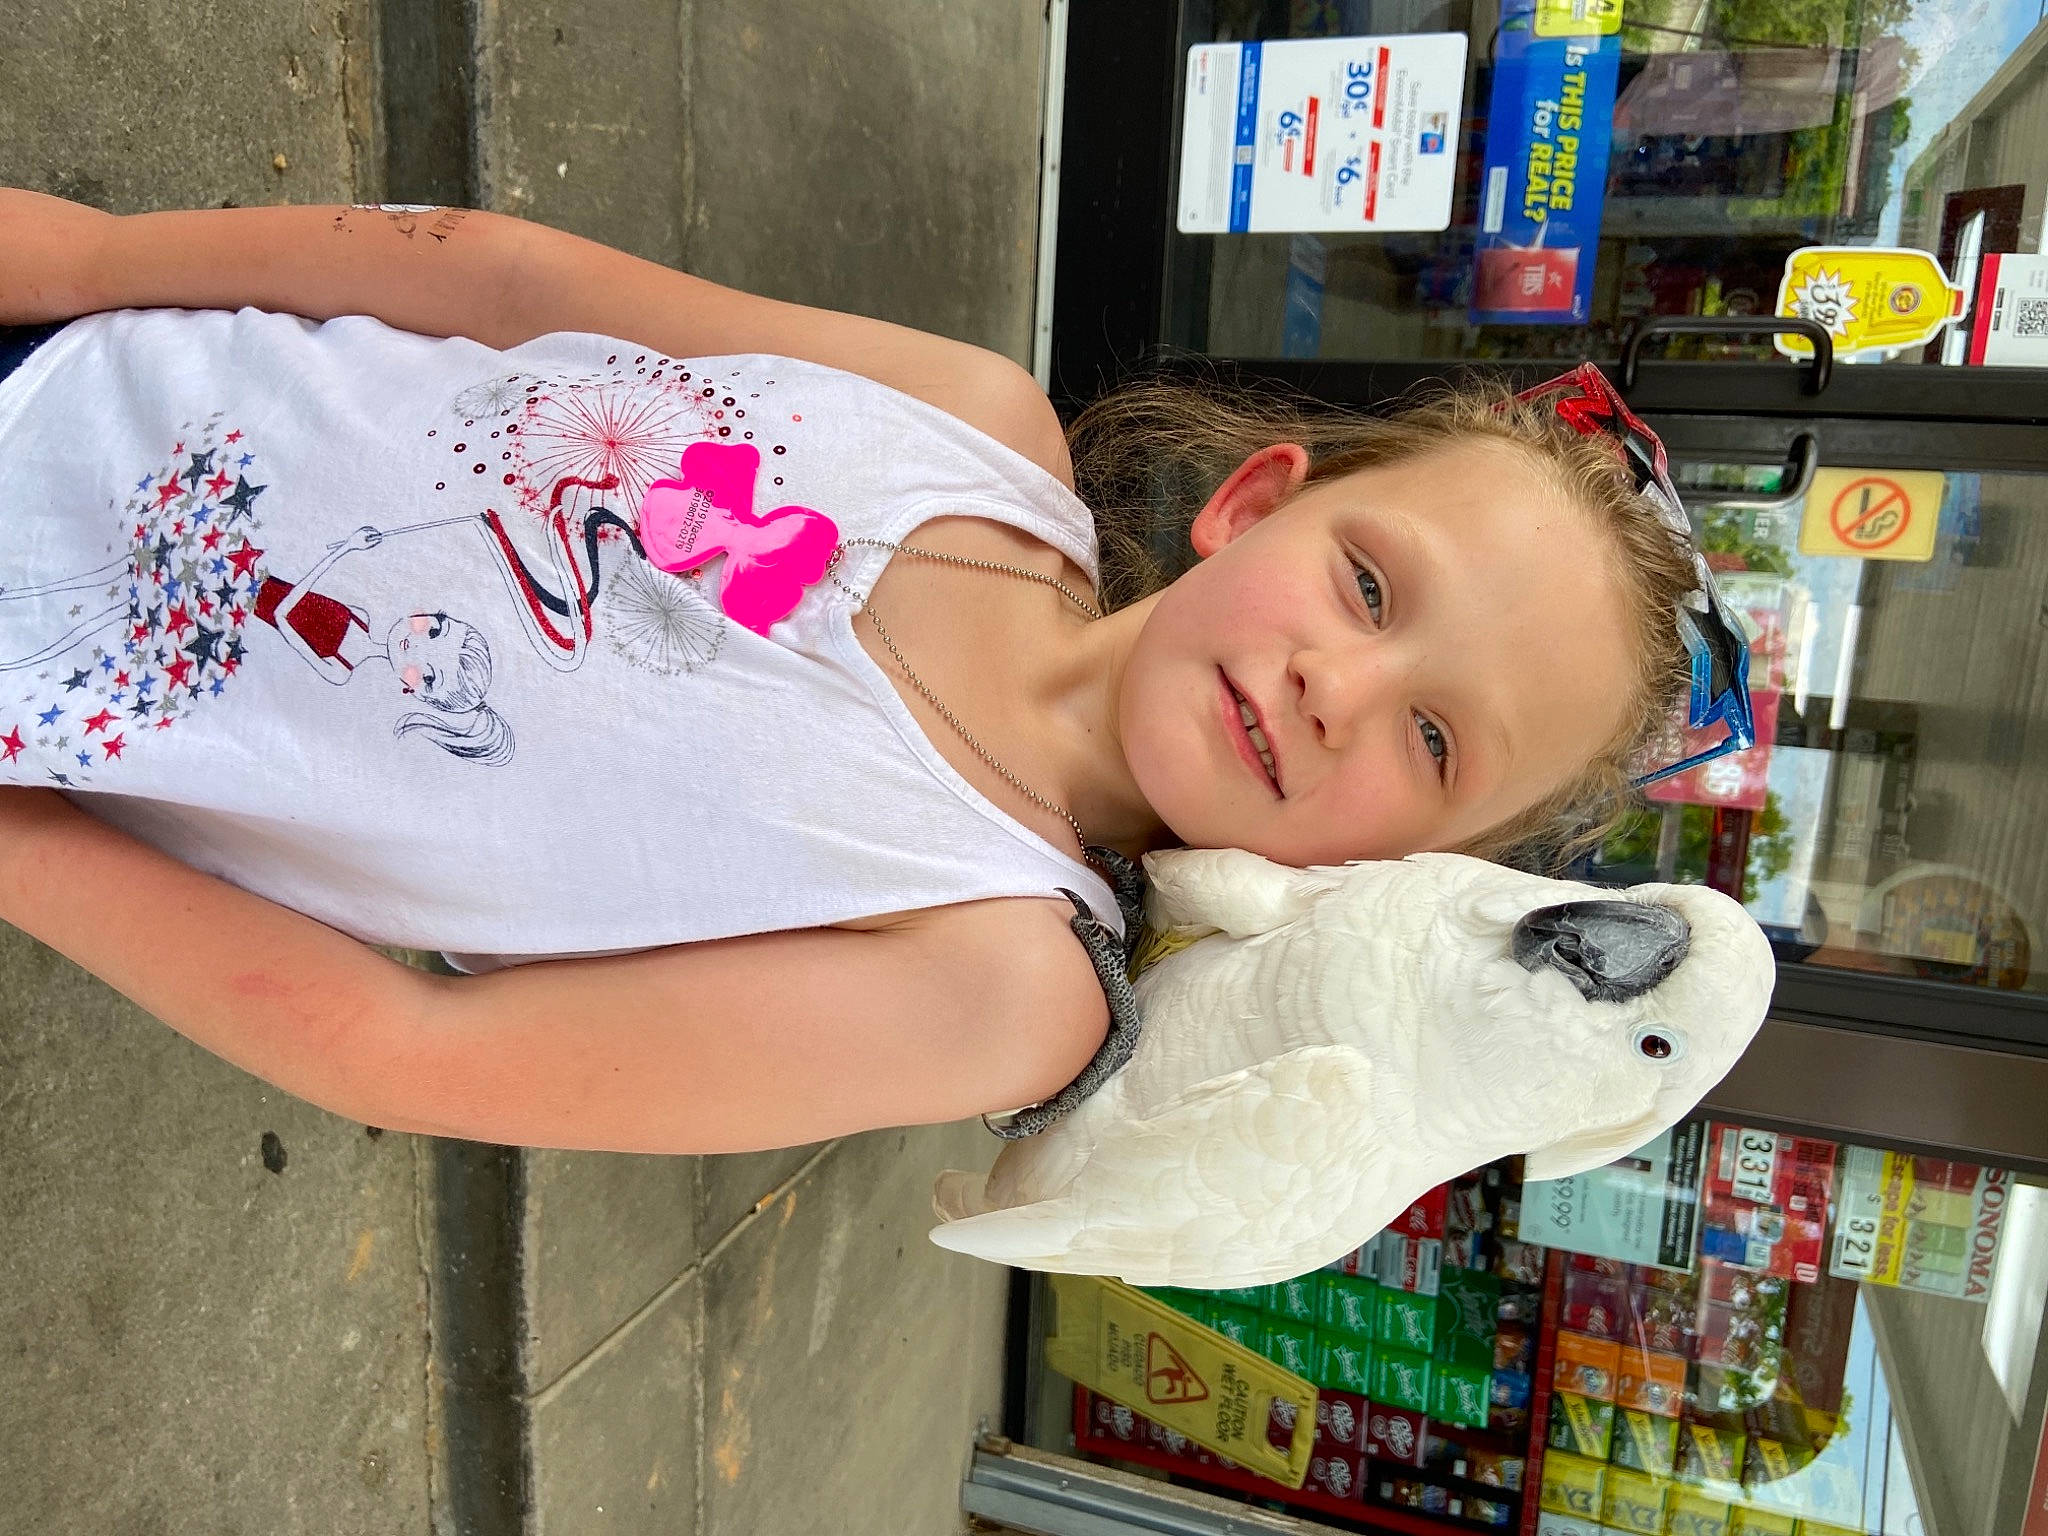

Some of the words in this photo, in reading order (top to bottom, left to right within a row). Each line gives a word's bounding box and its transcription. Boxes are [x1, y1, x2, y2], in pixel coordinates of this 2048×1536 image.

[1564, 45, 1589, 66] Is
[1532, 100, 1560, 138] for
[1558, 71, 1587, 130] THIS
[1523, 142, 1553, 223] REAL?
[1549, 135, 1578, 211] PRICE
[675, 487, 704, 550] 36198012-0219
[684, 520, 705, 553] Viacom
[1737, 1137, 1773, 1188] 331
[1884, 1153, 1911, 1212] Escape
[1842, 1219, 1875, 1270] 321
[1883, 1216, 1900, 1239] for
[1964, 1167, 2009, 1297] SONOMA
[1220, 1363, 1237, 1393] WET
[1215, 1396, 1233, 1443] FLOOR
[1232, 1378, 1250, 1441] CAUTION
